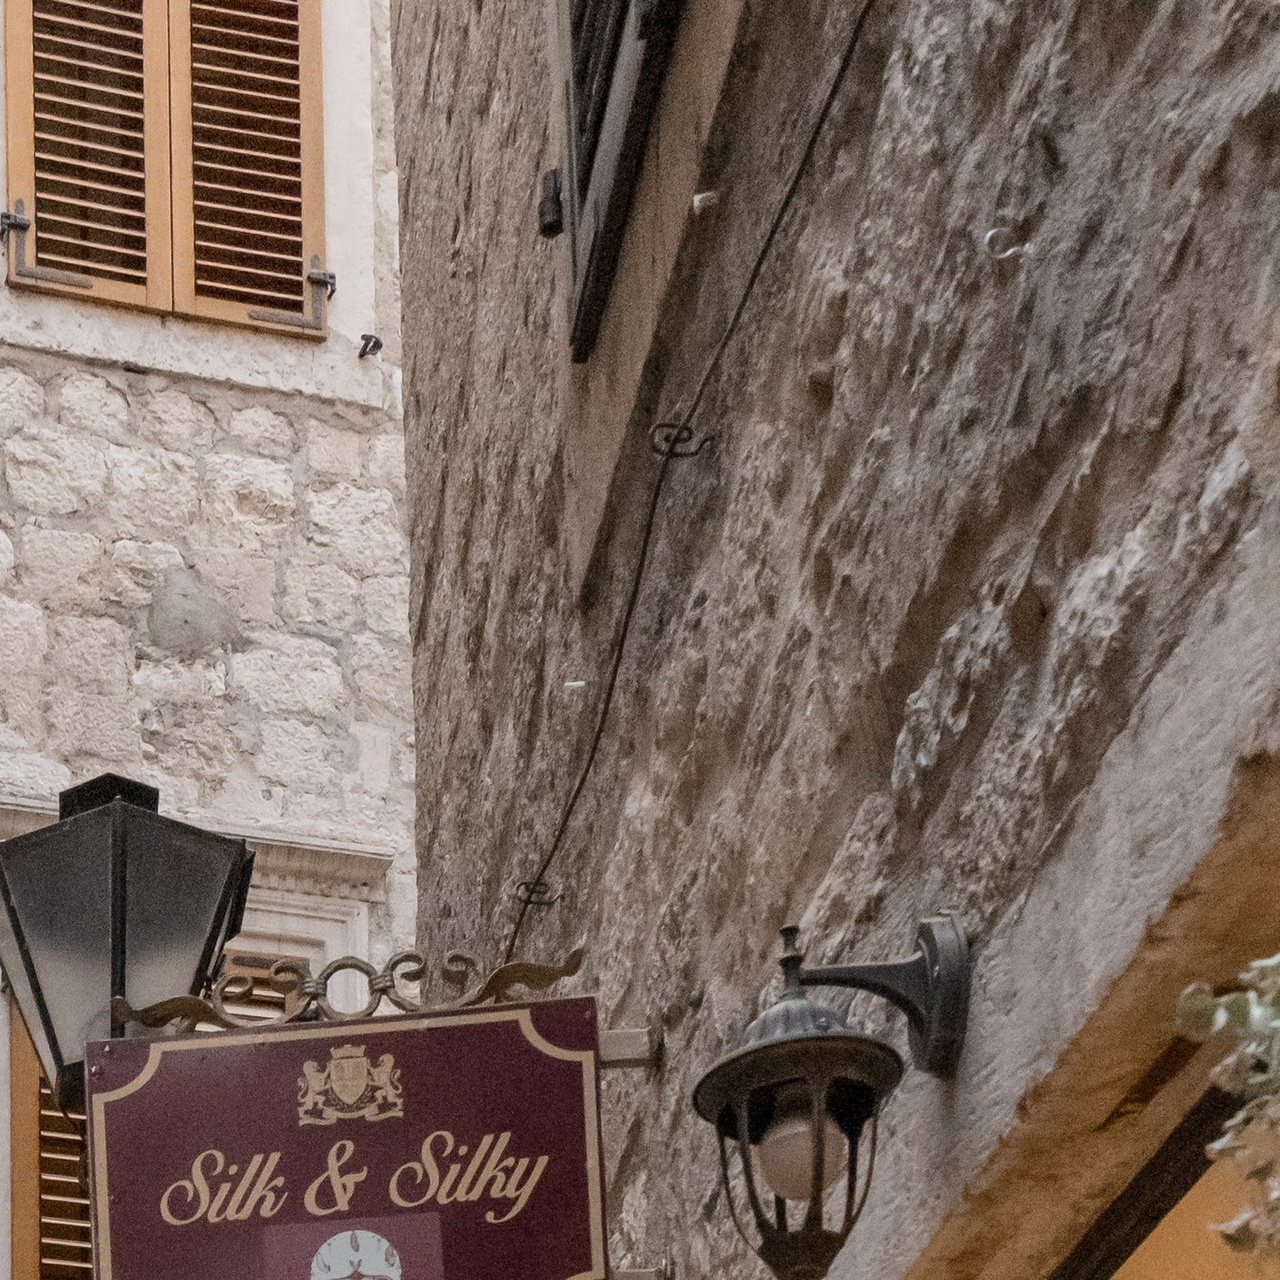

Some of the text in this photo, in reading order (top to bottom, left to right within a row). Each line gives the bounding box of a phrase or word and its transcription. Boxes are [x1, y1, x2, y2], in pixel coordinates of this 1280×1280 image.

[159, 1130, 550, 1226] Silk & Silky
